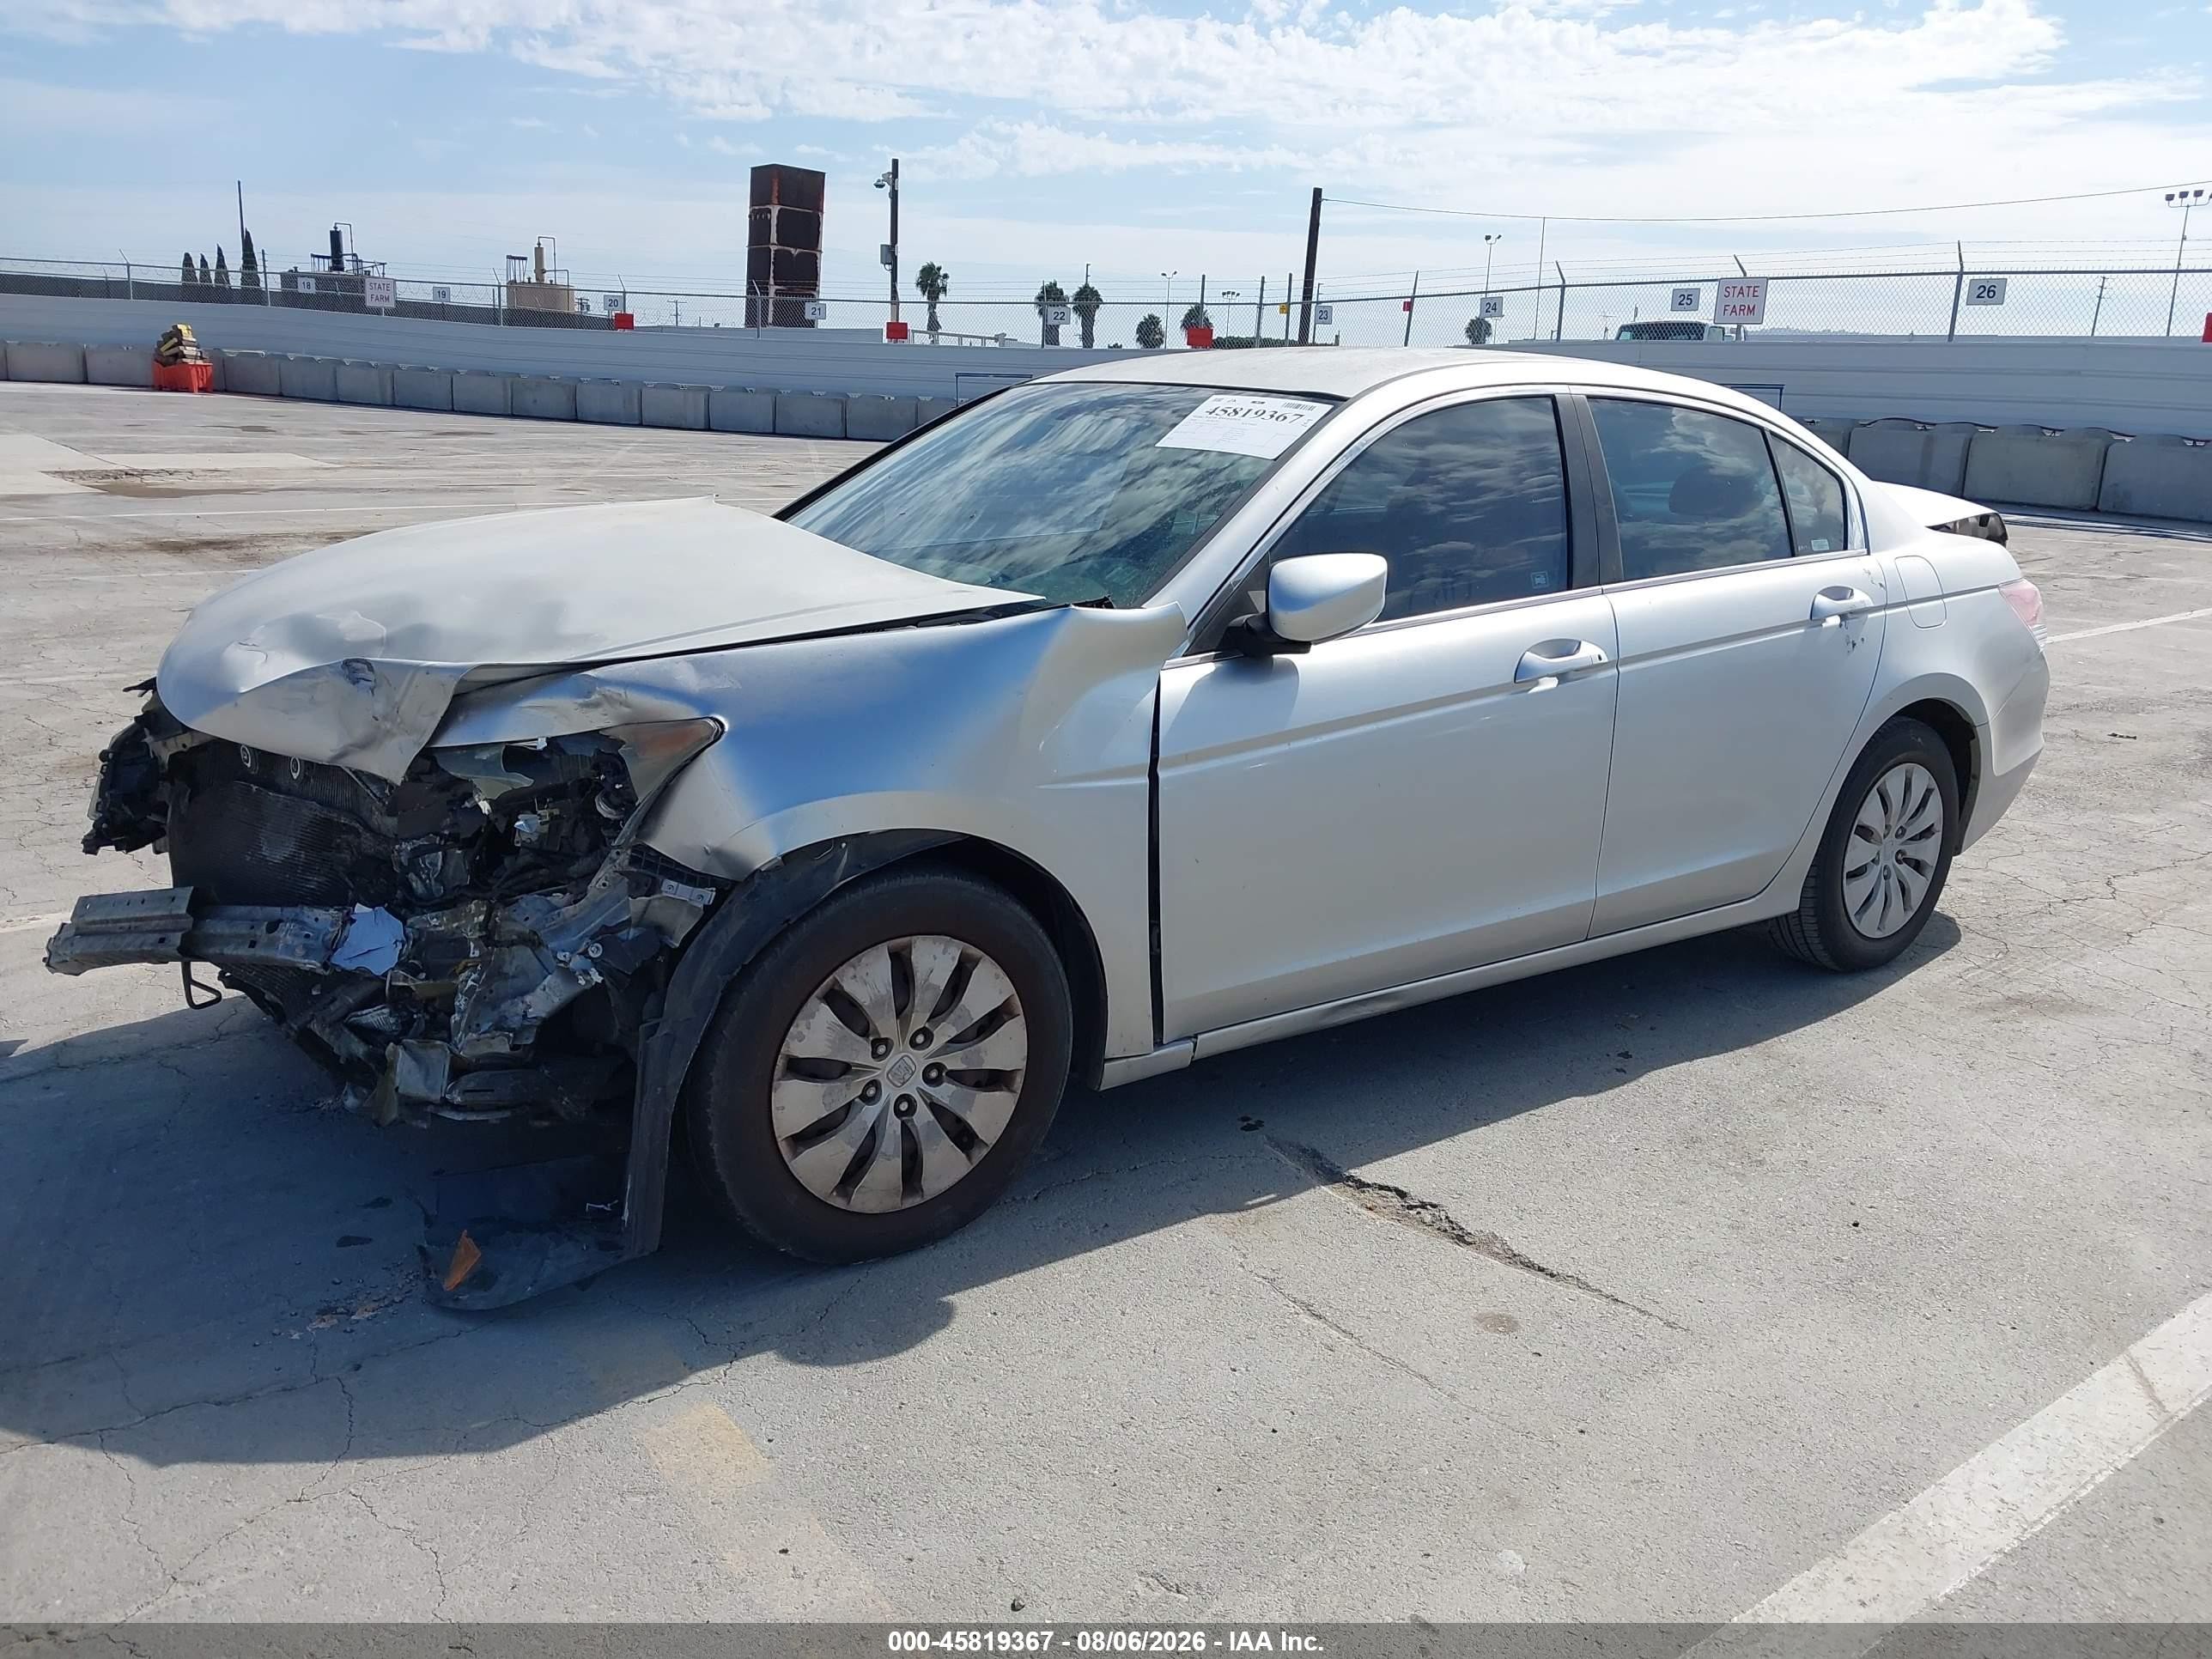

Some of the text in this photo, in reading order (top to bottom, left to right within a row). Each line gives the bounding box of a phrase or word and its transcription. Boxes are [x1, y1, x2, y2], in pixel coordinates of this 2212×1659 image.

[301, 282, 311, 290] 18
[369, 282, 391, 291] STATE
[437, 290, 447, 299] 19
[1723, 285, 1760, 298] STATE
[1976, 284, 1997, 299] 26
[370, 295, 390, 303] FARM
[608, 298, 619, 307] 20
[1678, 294, 1693, 306] 25
[811, 307, 822, 317] 21
[1486, 302, 1498, 313] 24
[1723, 304, 1756, 317] FARM
[1053, 311, 1066, 321] 22
[1318, 309, 1328, 320] 23
[1206, 406, 1305, 424] 45819367
